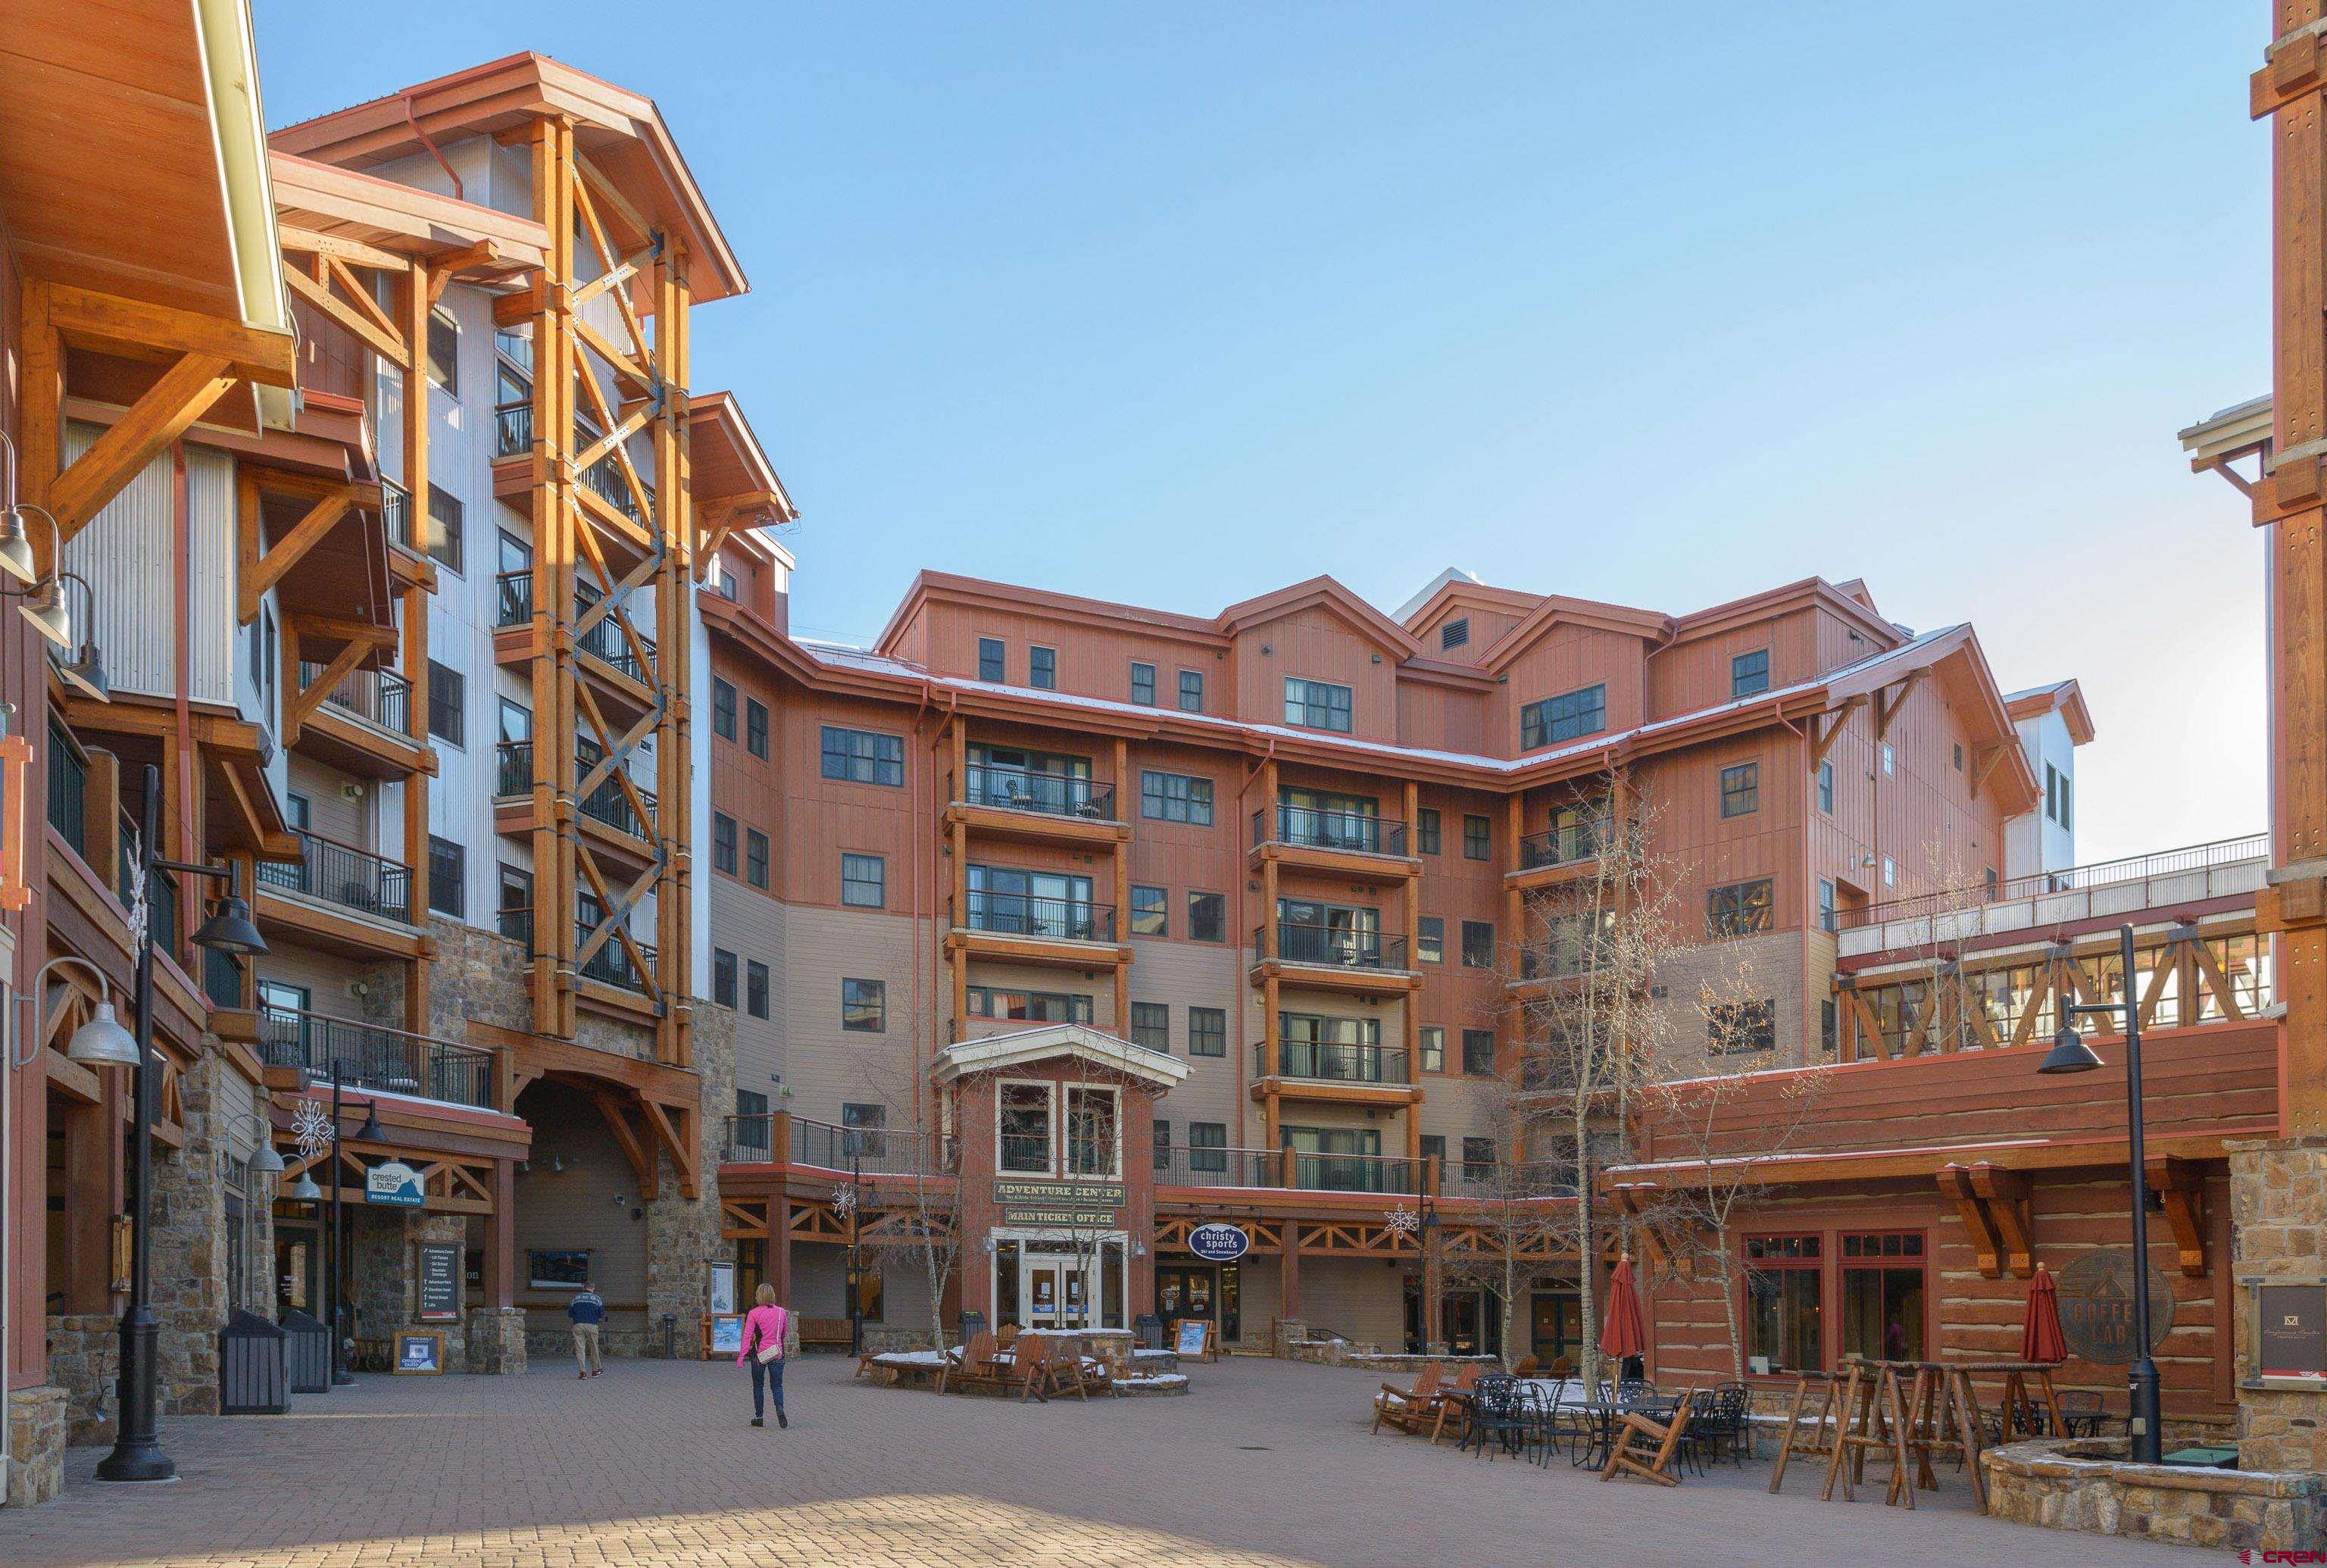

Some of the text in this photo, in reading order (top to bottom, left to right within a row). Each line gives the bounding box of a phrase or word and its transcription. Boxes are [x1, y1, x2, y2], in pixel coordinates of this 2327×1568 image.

[372, 1173, 401, 1182] crested
[376, 1181, 397, 1190] butte
[998, 1185, 1071, 1195] ADVENTURE
[1008, 1212, 1035, 1220] MAIN
[1037, 1213, 1073, 1222] TICKET
[1201, 1231, 1235, 1244] christy
[1206, 1240, 1238, 1250] sports
[2072, 1302, 2135, 1323] COFFE
[2091, 1324, 2126, 1345] LAB
